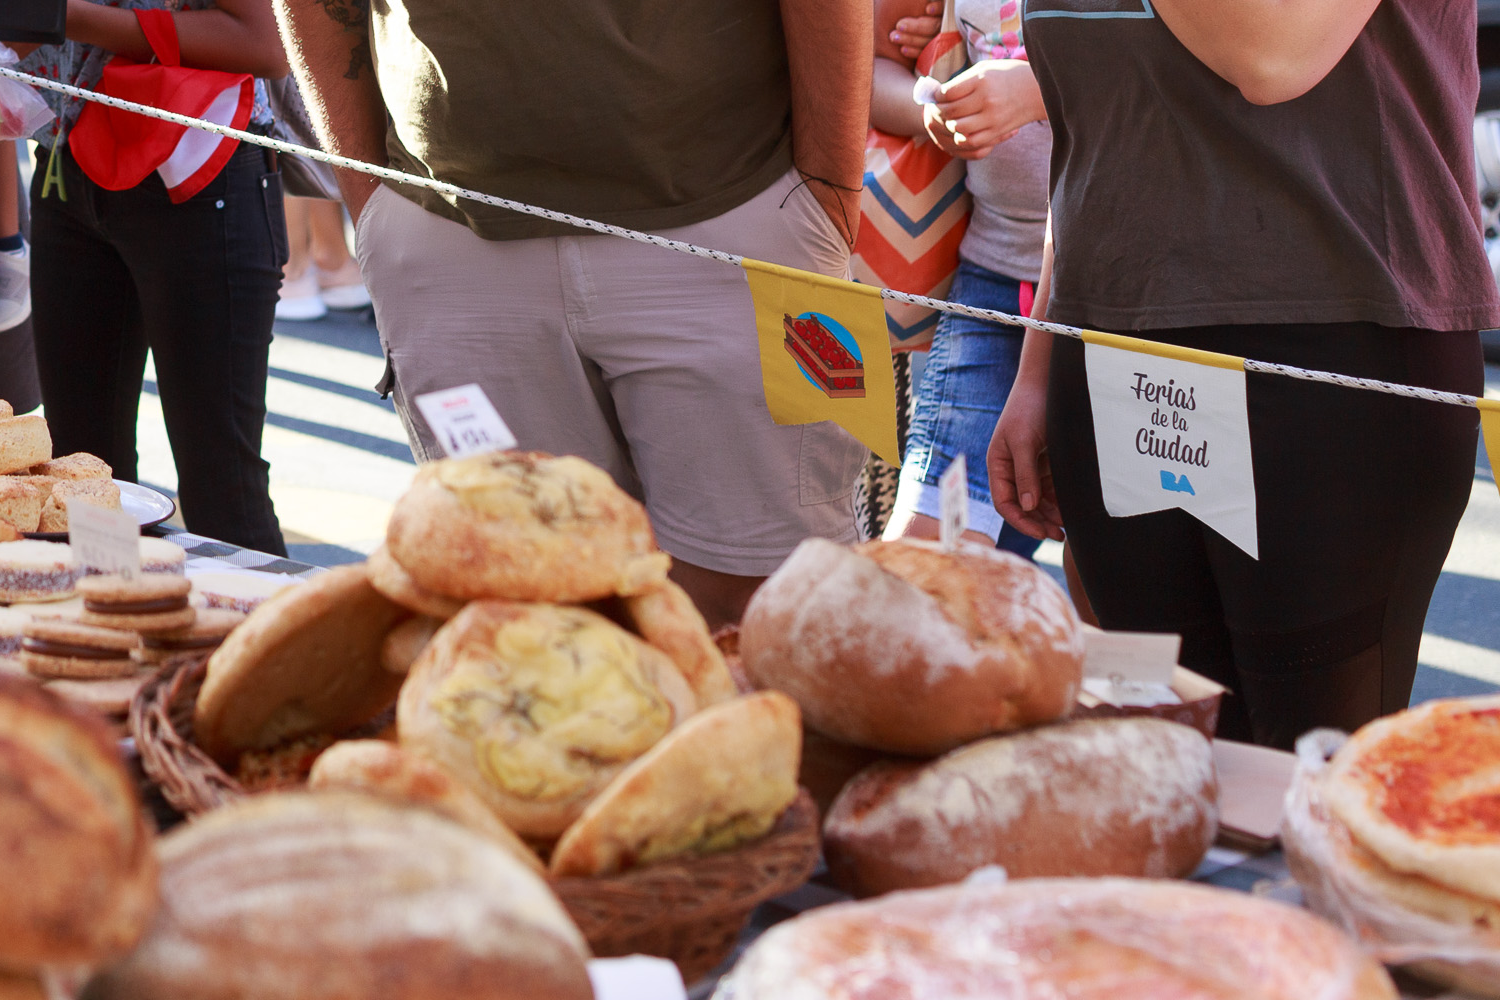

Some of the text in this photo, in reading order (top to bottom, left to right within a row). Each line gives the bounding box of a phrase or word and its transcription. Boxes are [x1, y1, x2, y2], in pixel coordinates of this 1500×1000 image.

[1130, 373, 1196, 410] Ferias
[1151, 408, 1189, 432] de la
[1135, 428, 1209, 468] Ciudad
[1160, 470, 1195, 495] BA
